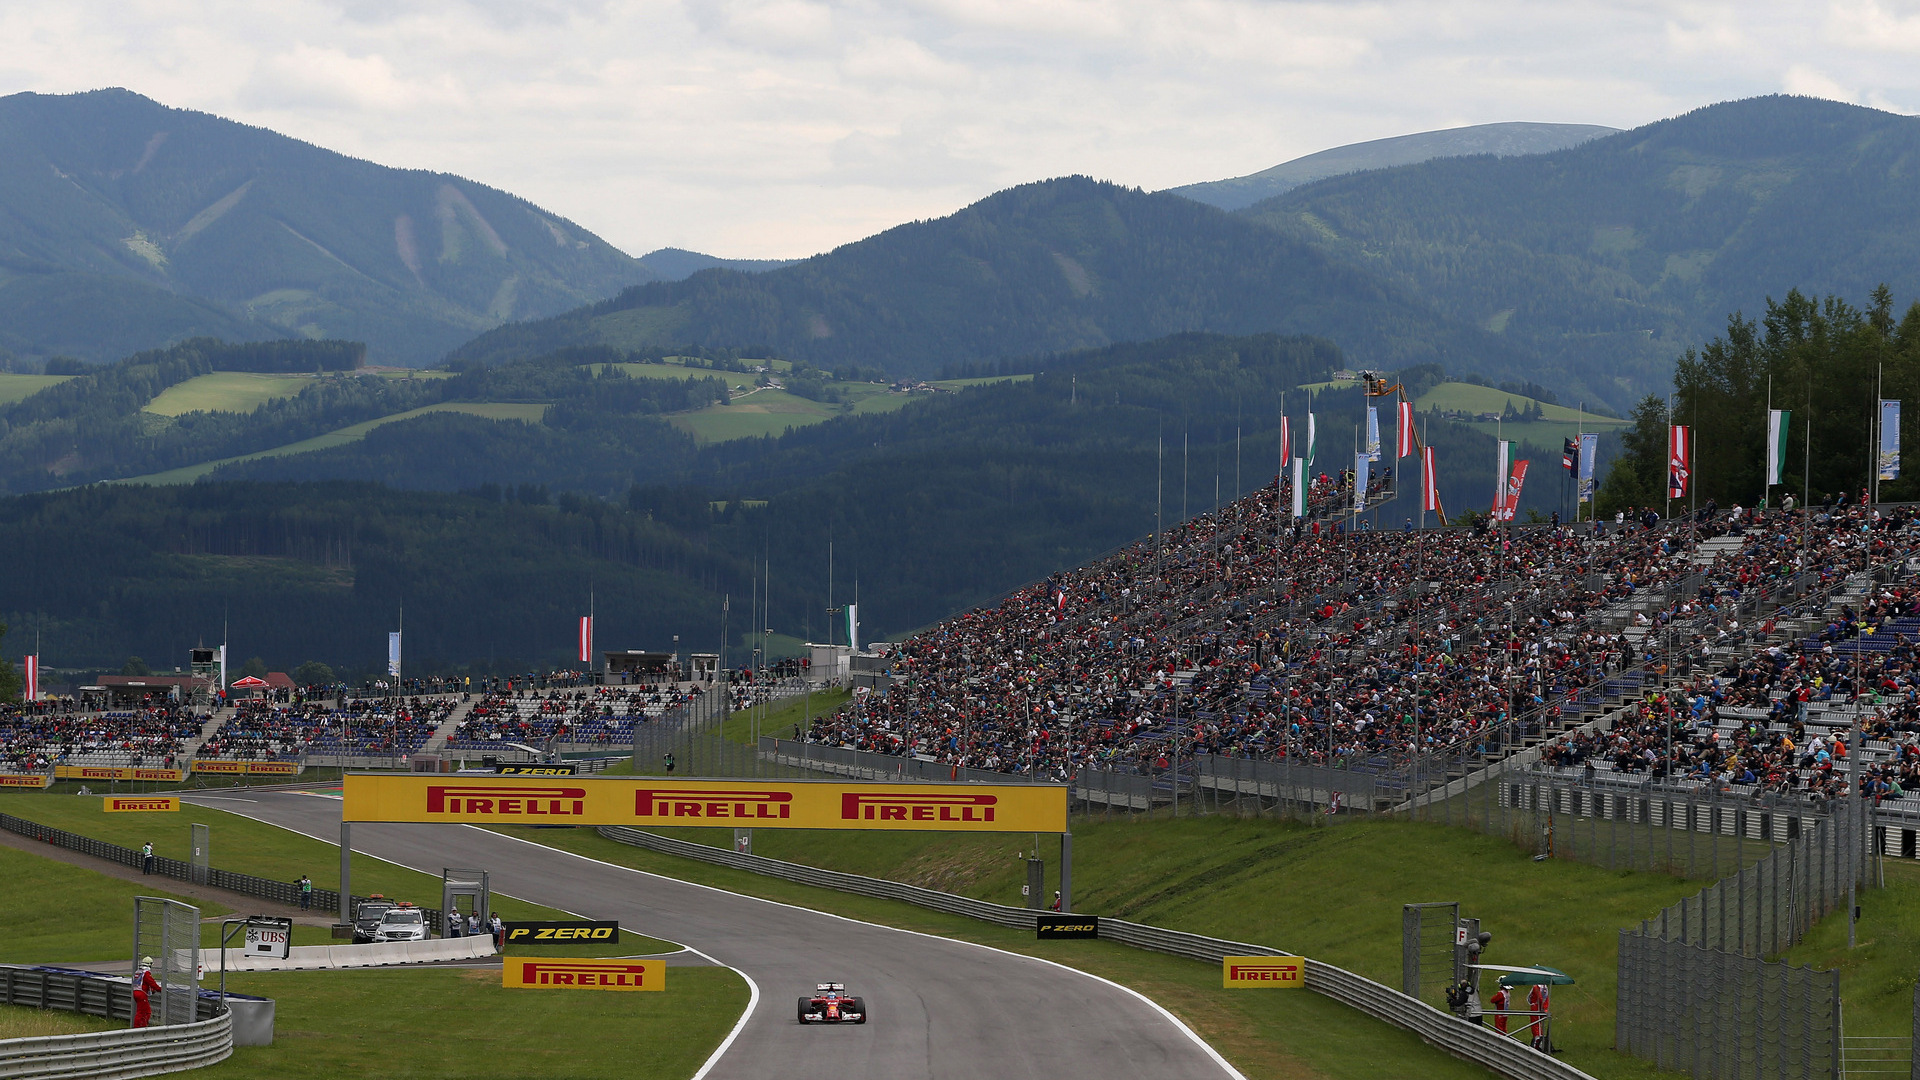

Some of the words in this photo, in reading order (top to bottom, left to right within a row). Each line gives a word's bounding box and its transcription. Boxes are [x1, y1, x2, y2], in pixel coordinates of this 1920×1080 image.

[197, 762, 238, 771] PIRELLI
[250, 763, 292, 772] PIRELLI
[82, 769, 123, 778] PIRELLI
[135, 770, 176, 779] PIRELLI
[113, 800, 170, 810] PIRELLI
[427, 786, 587, 815] PIRELLI
[635, 789, 793, 819] PIRELLI
[841, 793, 998, 822] PIRELLI
[261, 931, 286, 943] UBS
[509, 928, 530, 940] P
[534, 928, 613, 939] ZERO
[1459, 931, 1465, 942] F
[523, 963, 646, 987] PIRELLI
[1230, 965, 1298, 981] PIRELLI
